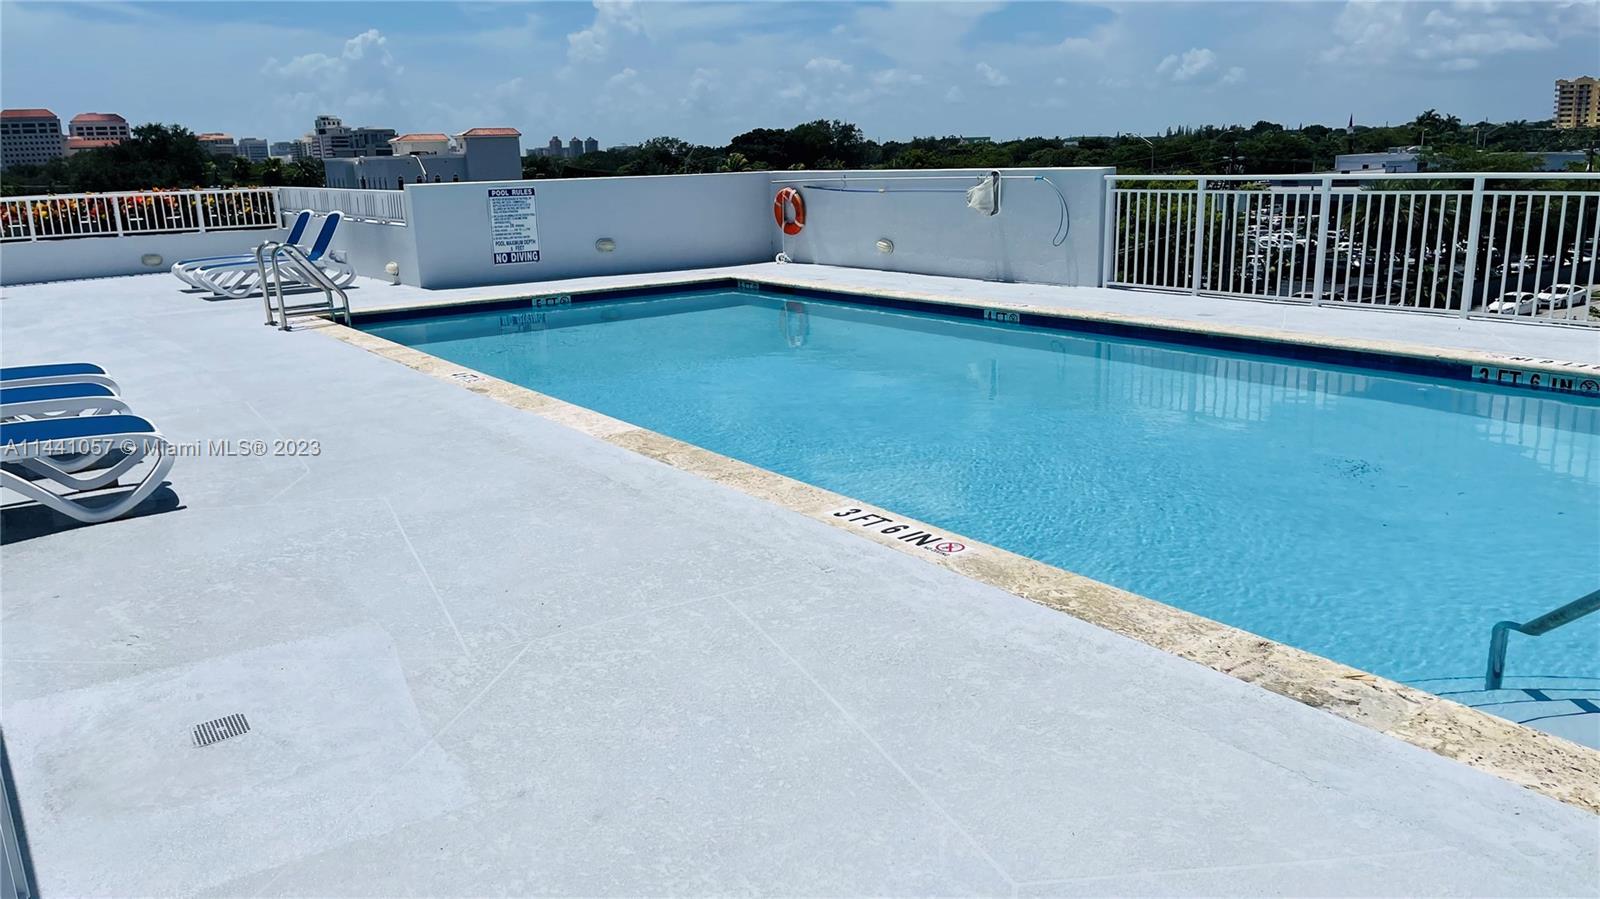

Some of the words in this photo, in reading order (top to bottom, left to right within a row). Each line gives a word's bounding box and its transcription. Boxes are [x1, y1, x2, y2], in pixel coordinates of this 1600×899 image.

[496, 253, 508, 263] NO
[510, 251, 538, 262] DIVING
[1497, 369, 1522, 386] FT
[1551, 377, 1573, 391] IN
[833, 508, 862, 517] 3
[848, 513, 893, 527] FT
[880, 524, 910, 534] 6
[897, 531, 943, 547] IN
